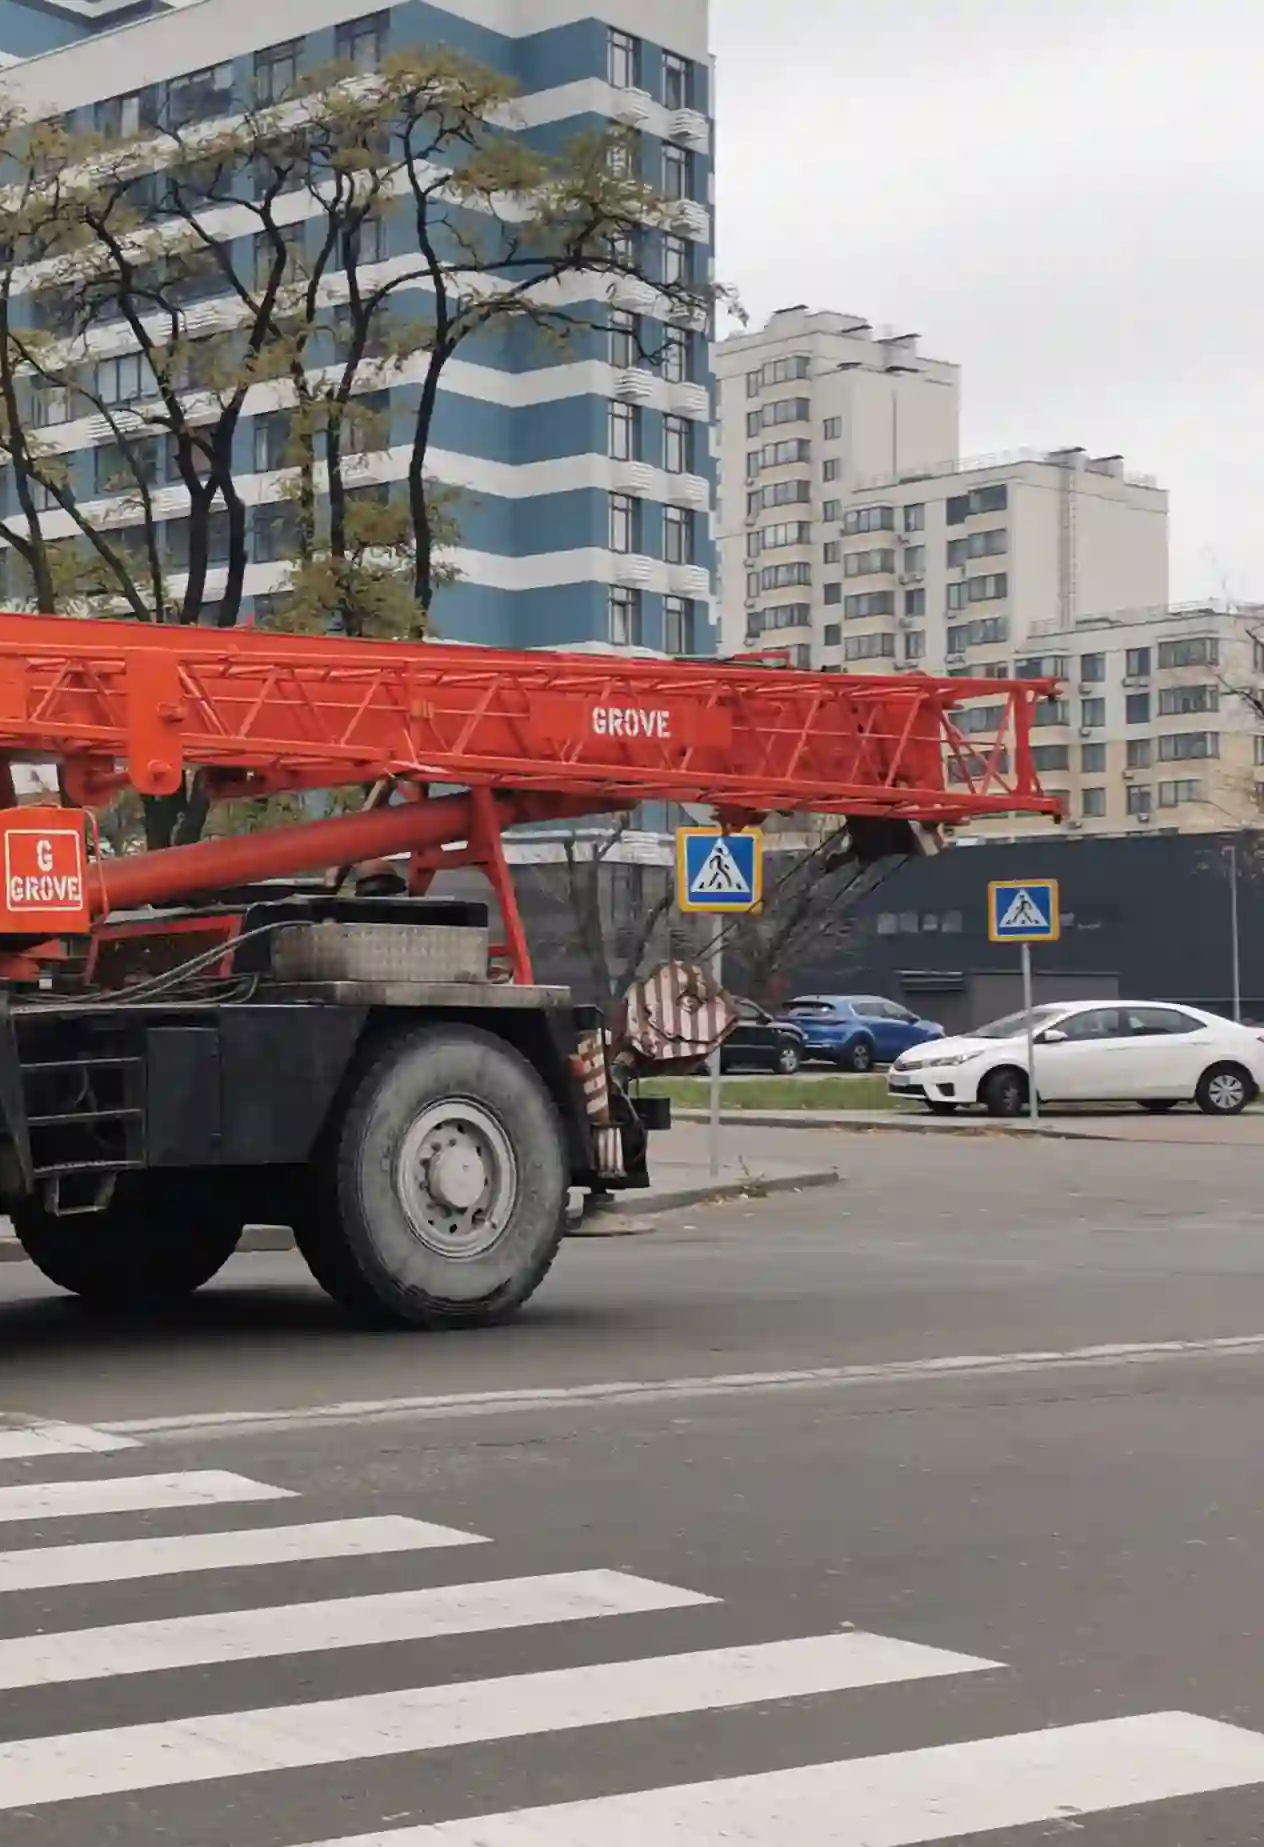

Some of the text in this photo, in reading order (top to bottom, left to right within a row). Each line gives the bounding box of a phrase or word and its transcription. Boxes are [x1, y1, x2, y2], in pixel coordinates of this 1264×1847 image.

[592, 706, 671, 738] GROVE
[37, 839, 54, 872] G
[11, 875, 82, 902] GROVE
